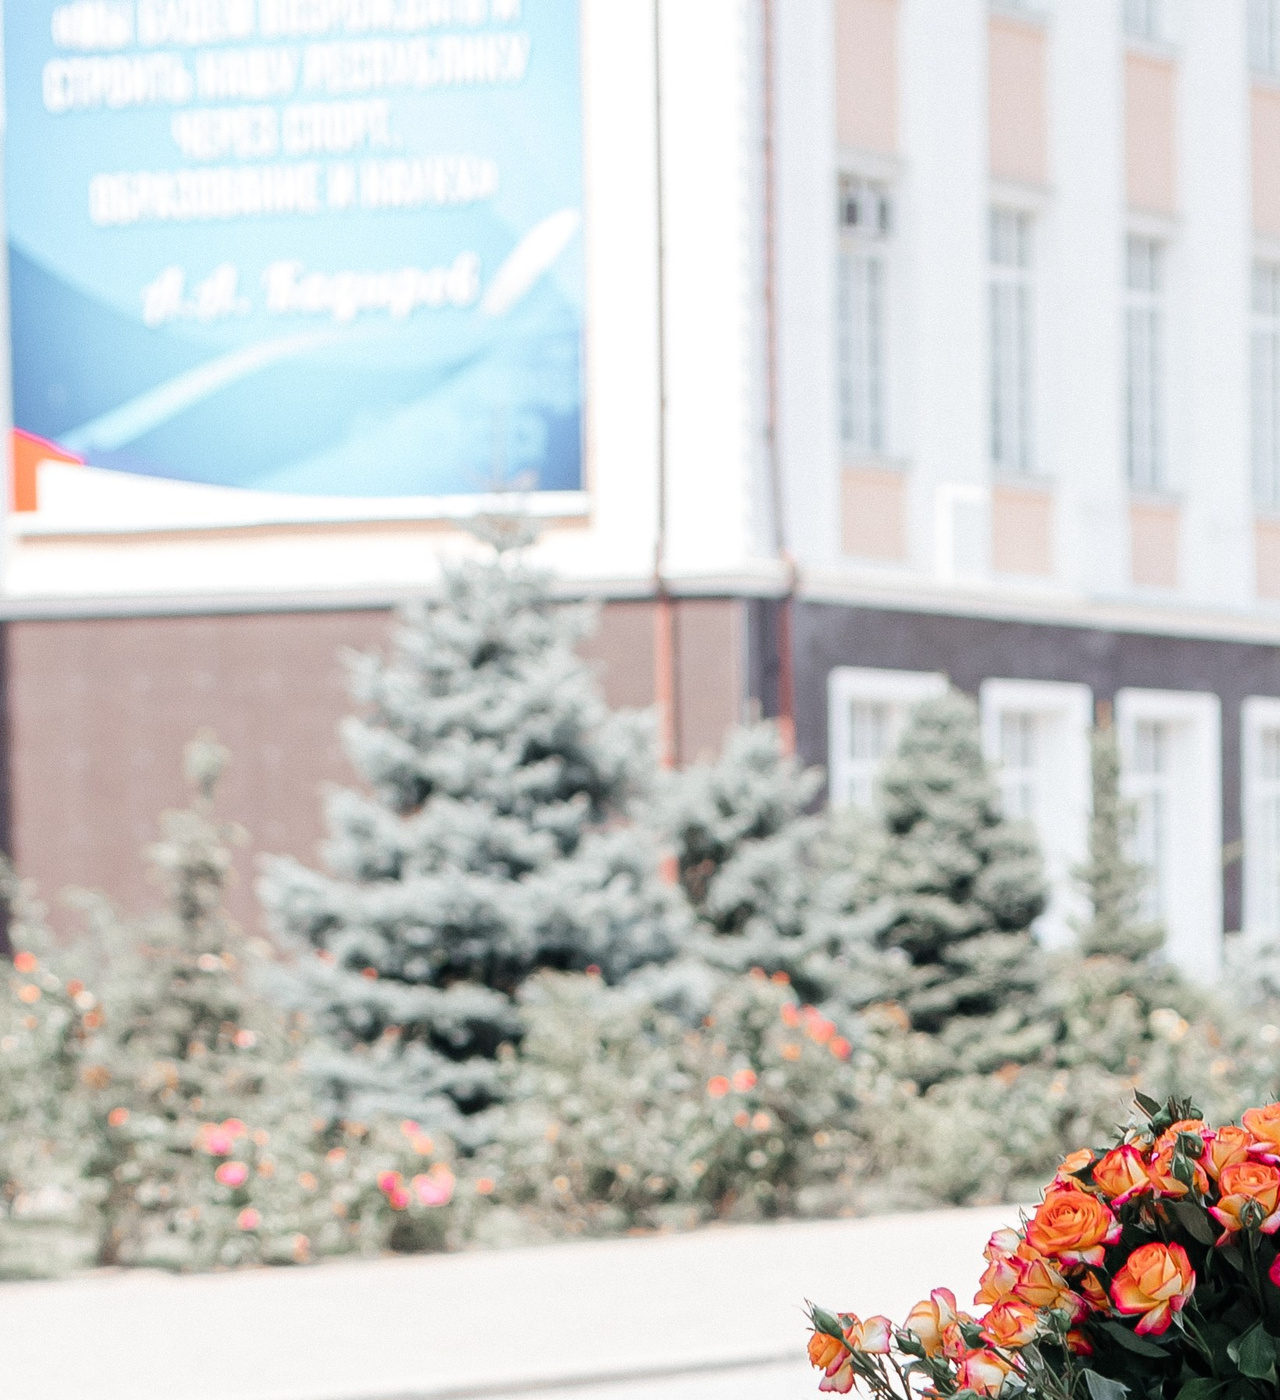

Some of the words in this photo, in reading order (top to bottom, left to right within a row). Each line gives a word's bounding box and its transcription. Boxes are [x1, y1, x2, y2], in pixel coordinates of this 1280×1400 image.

[43, 58, 193, 112] СТРОИТЬ
[197, 49, 298, 98] НАШУ
[302, 34, 528, 91] РЕСПУБЛИКУ
[172, 107, 278, 158] ЧЕРЕЗ
[90, 165, 320, 224] ОБРАЗОВАНИЕ
[326, 162, 354, 206] И
